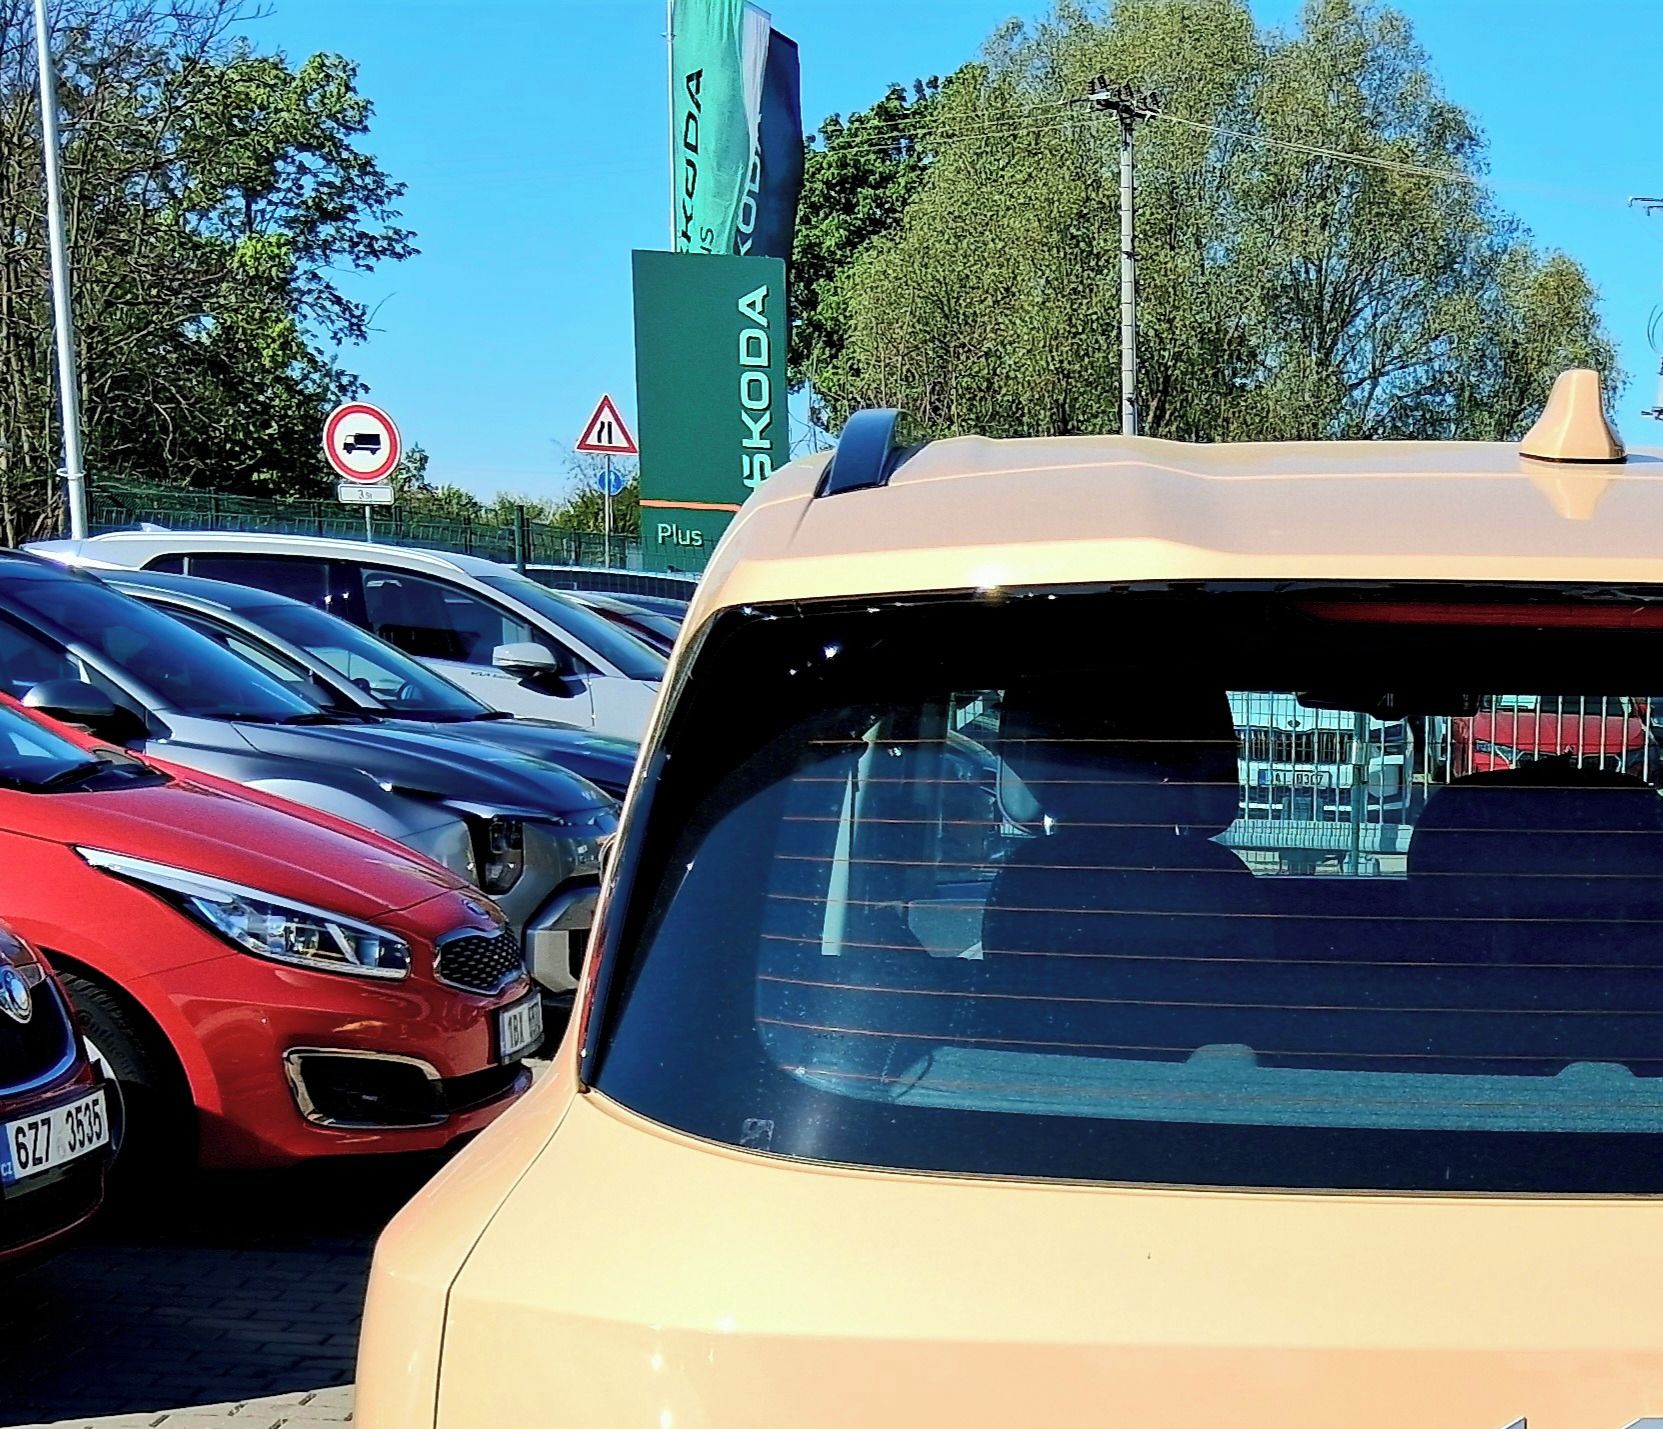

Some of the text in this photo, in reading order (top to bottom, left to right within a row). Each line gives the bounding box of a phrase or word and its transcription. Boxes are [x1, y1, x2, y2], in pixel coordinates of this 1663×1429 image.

[678, 68, 704, 254] KODA
[657, 523, 703, 546] Plus
[14, 1098, 103, 1170] 6Z7 3535
[1, 1161, 13, 1177] CZ
